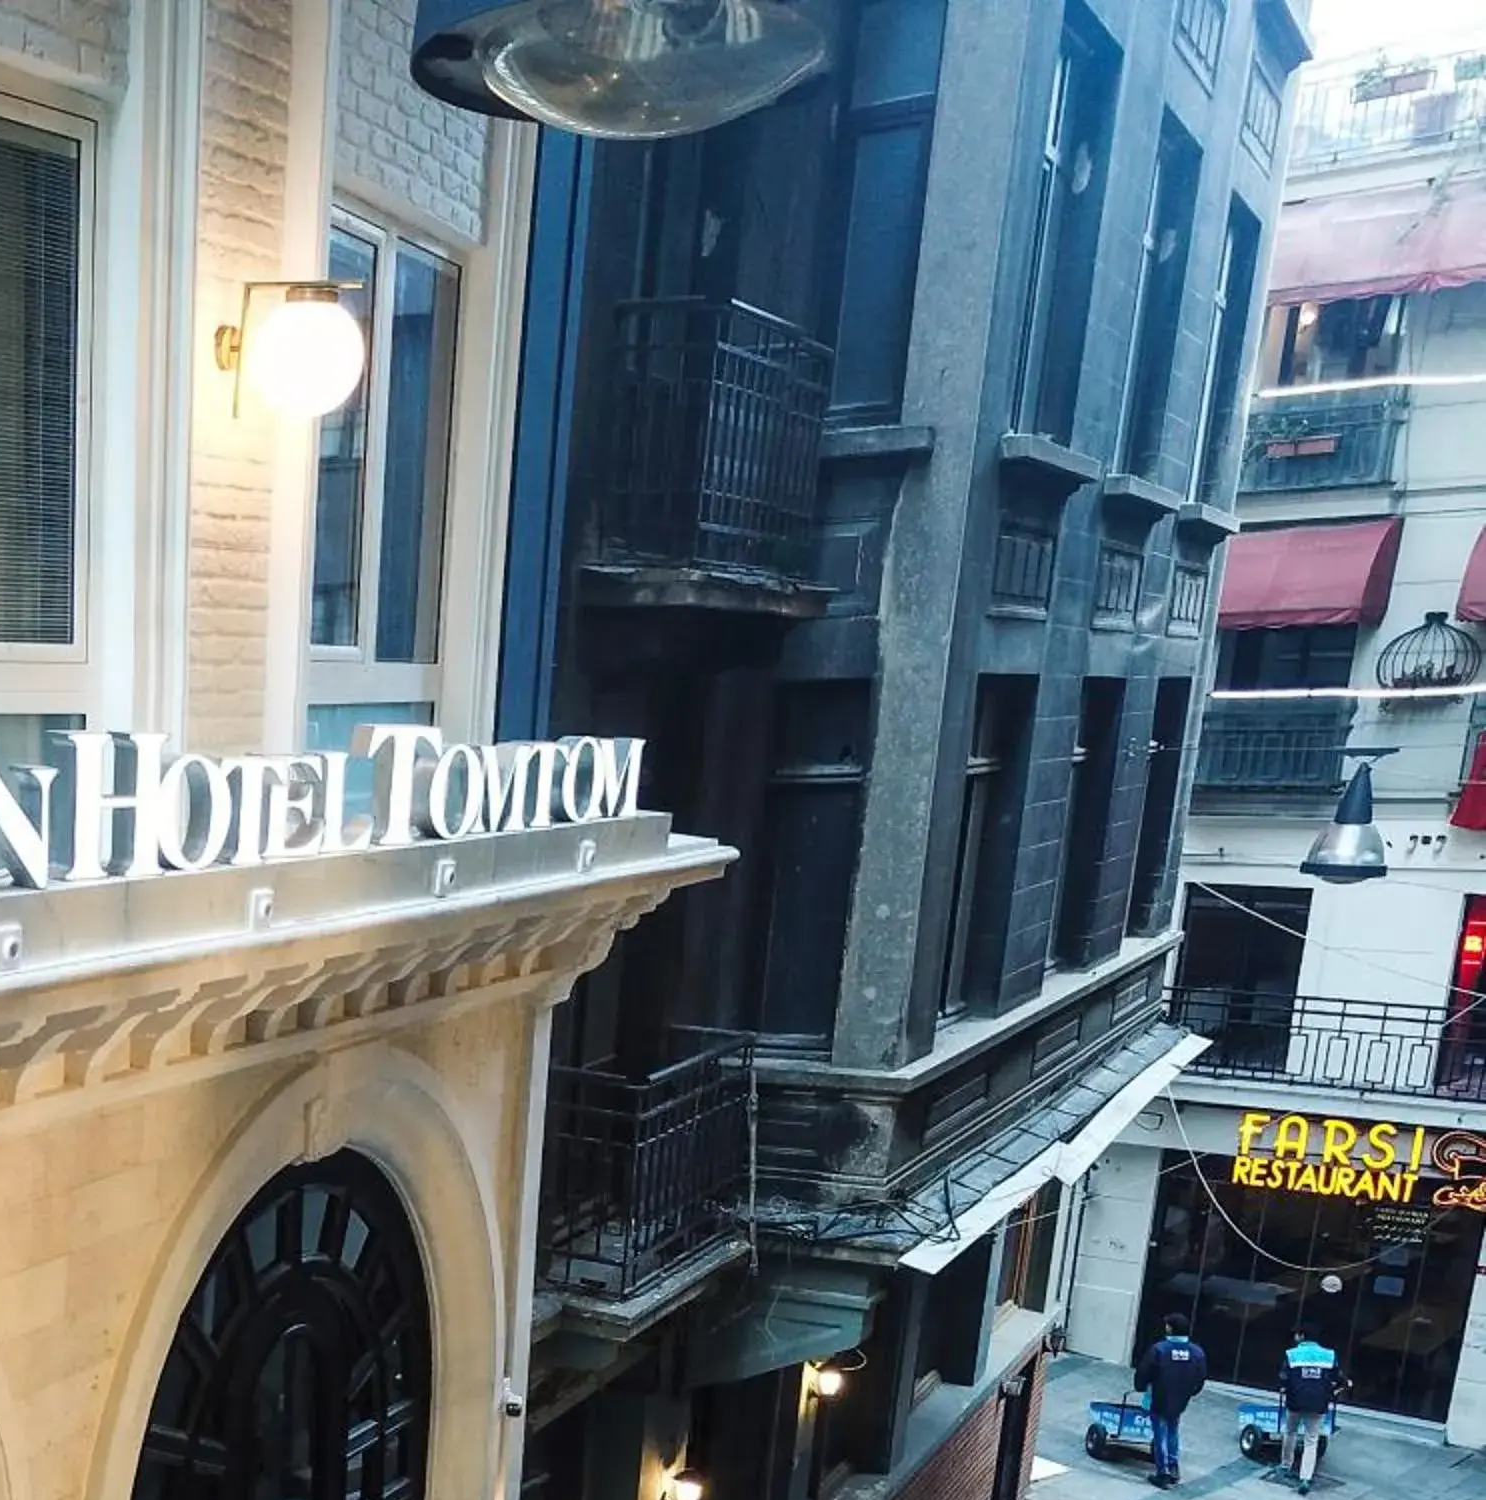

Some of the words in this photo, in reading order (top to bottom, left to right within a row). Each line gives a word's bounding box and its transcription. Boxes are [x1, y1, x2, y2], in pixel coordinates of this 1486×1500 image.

[52, 731, 375, 880] HOTEL
[356, 724, 646, 846] TOMTOM
[1236, 1111, 1426, 1172] FARSI
[1231, 1156, 1419, 1204] RESTAURANT
